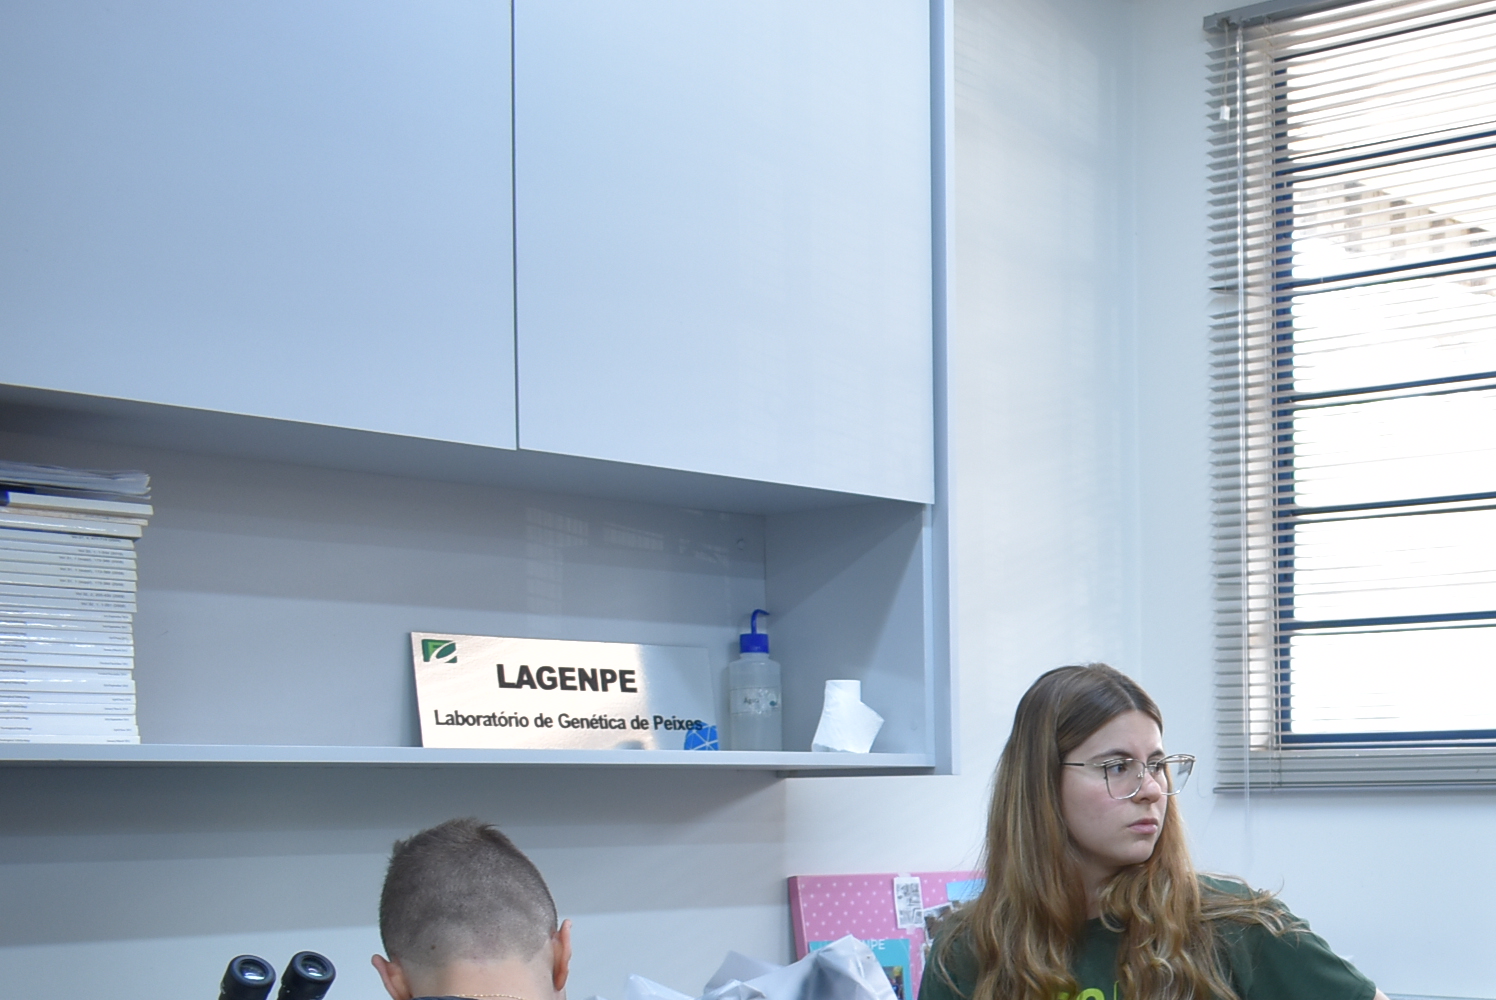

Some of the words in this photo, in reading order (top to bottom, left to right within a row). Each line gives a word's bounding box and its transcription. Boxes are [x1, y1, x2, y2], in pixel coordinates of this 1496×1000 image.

[496, 664, 638, 693] LAGENPE
[434, 709, 530, 730] Laboratório
[534, 713, 553, 729] de
[558, 713, 626, 730] Genética
[632, 714, 650, 731] de
[653, 715, 704, 732] Peixes
